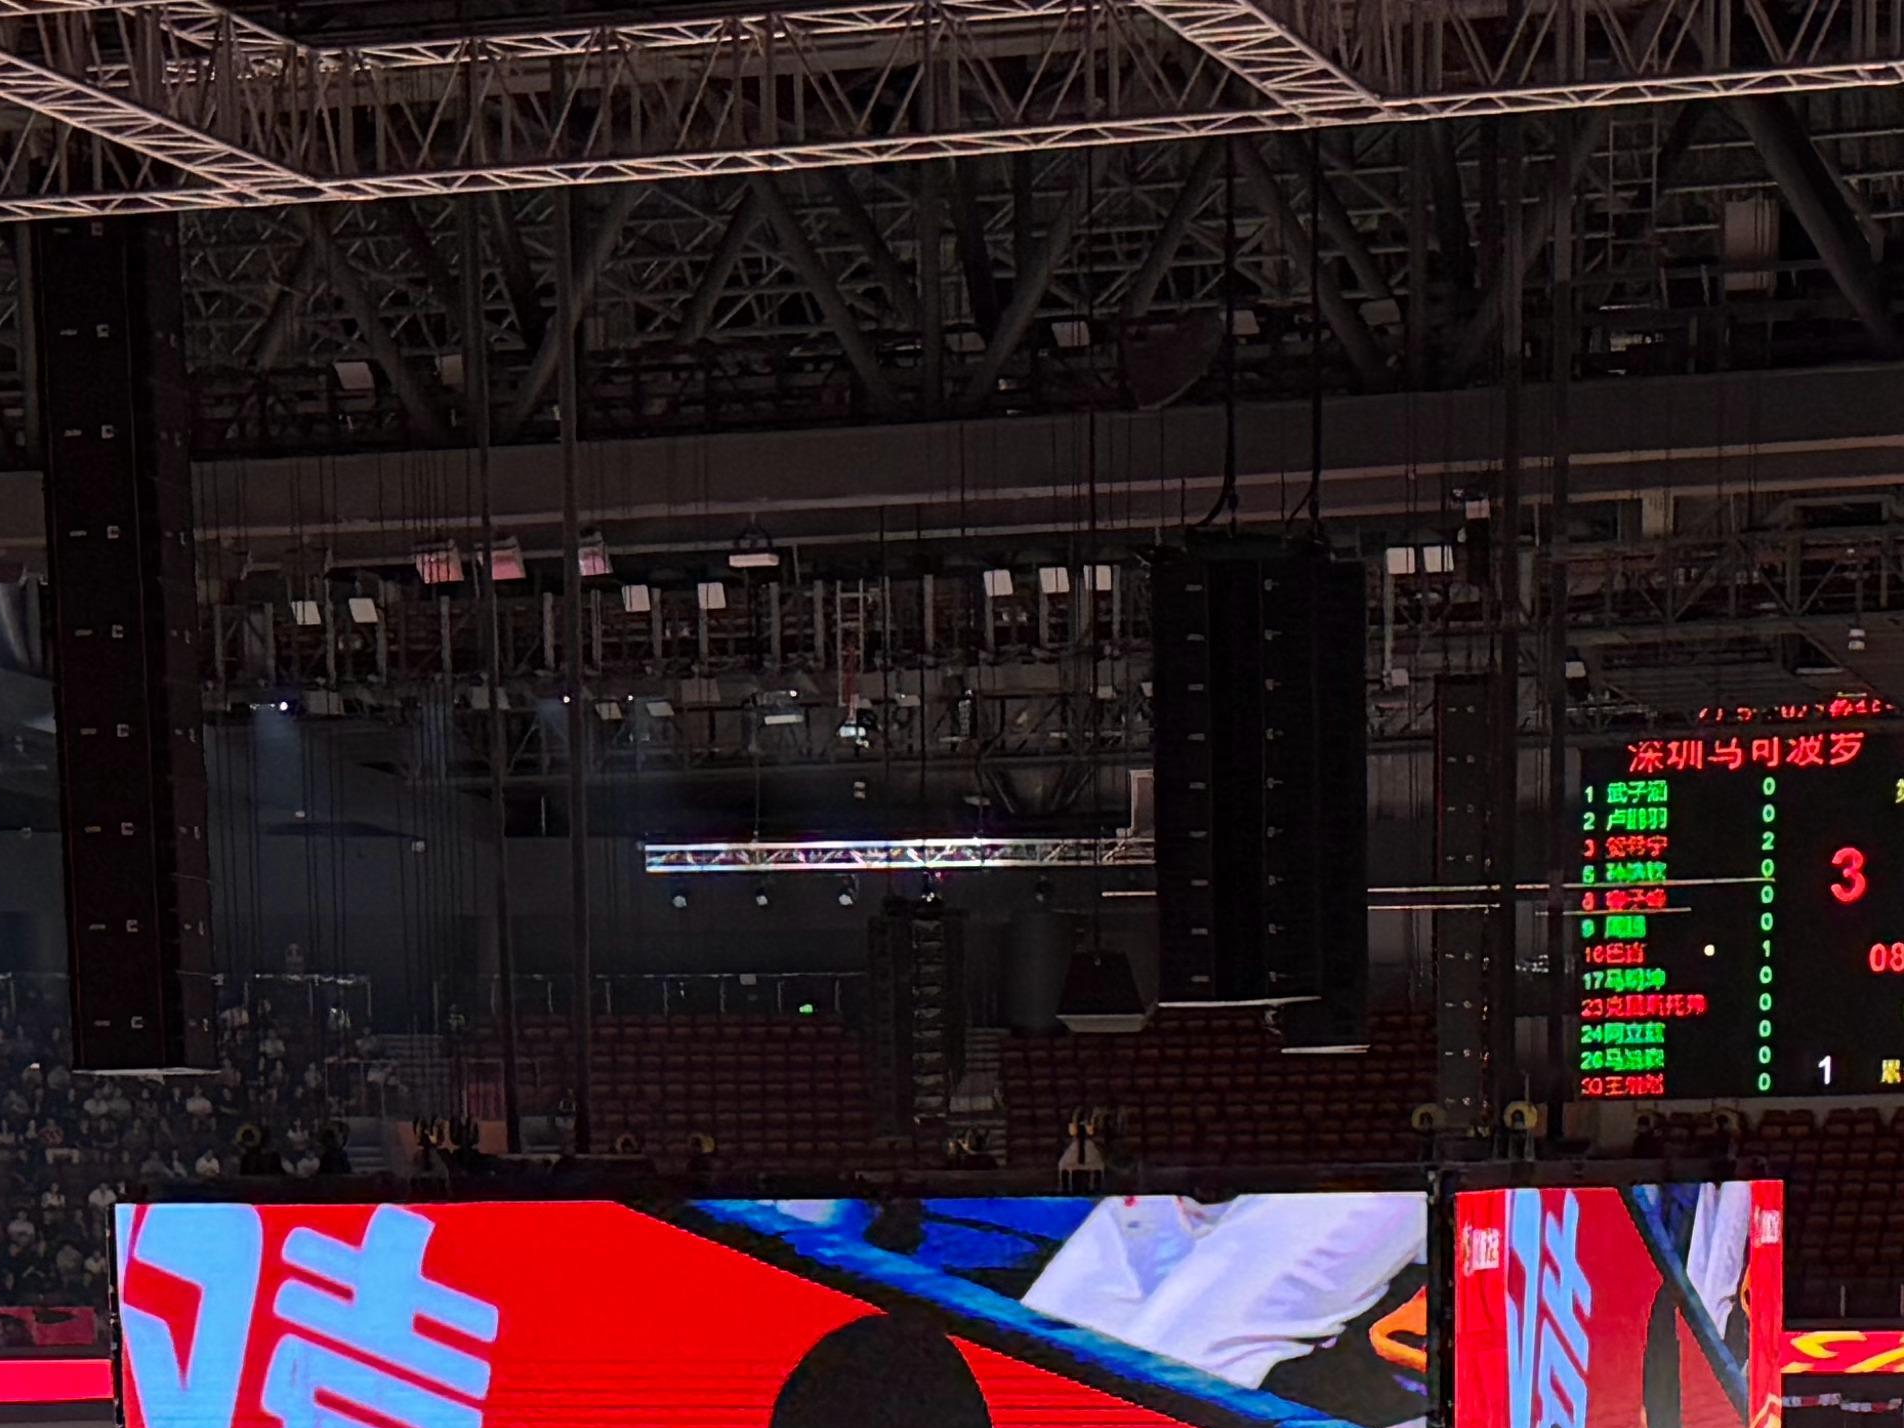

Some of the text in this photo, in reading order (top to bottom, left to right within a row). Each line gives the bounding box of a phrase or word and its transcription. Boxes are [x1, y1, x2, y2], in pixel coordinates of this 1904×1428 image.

[1628, 733, 1864, 773] 深圳马可波罗
[1585, 787, 1593, 802] 1
[1763, 778, 1776, 795] 0
[1583, 814, 1595, 830] 2
[1762, 805, 1775, 822] 0
[1762, 833, 1774, 850] 2
[1761, 859, 1774, 877] 0
[1830, 847, 1867, 902] 3
[1761, 885, 1774, 903] 0
[1761, 913, 1773, 931] 0
[1762, 941, 1770, 957] 1
[1583, 972, 1603, 990] 17
[1760, 966, 1772, 983] 0
[1760, 993, 1772, 1010] 0
[1759, 1019, 1771, 1037] 0
[1759, 1046, 1771, 1064] 0
[1817, 1055, 1834, 1084] 1
[1758, 1073, 1771, 1091] 0
